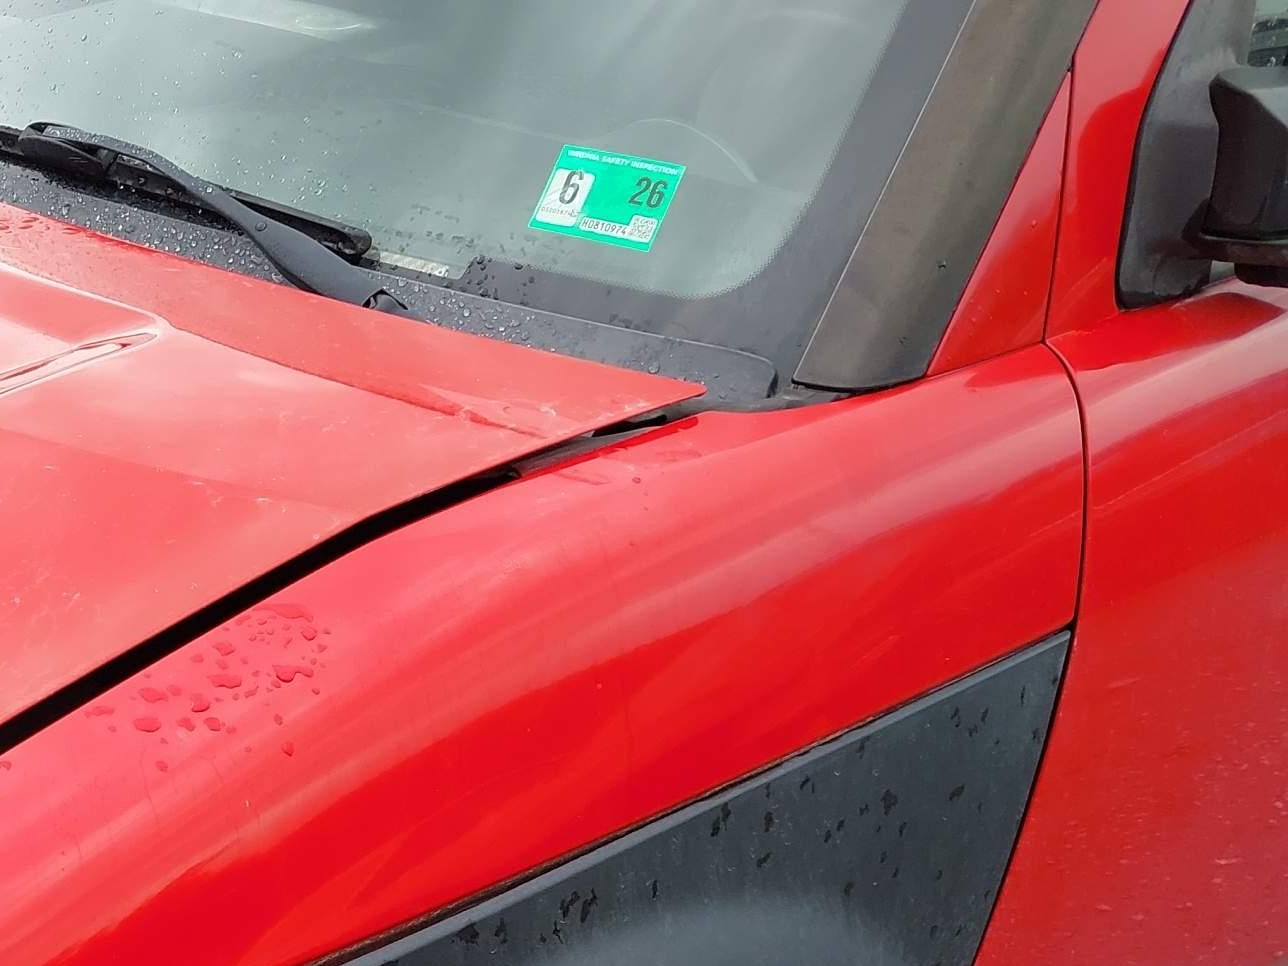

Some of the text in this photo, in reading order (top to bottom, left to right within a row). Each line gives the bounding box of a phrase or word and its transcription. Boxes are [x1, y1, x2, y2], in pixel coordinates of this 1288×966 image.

[602, 155, 630, 167] SAFETY
[631, 160, 679, 175] INSPECTION
[559, 170, 668, 209] 6 26
